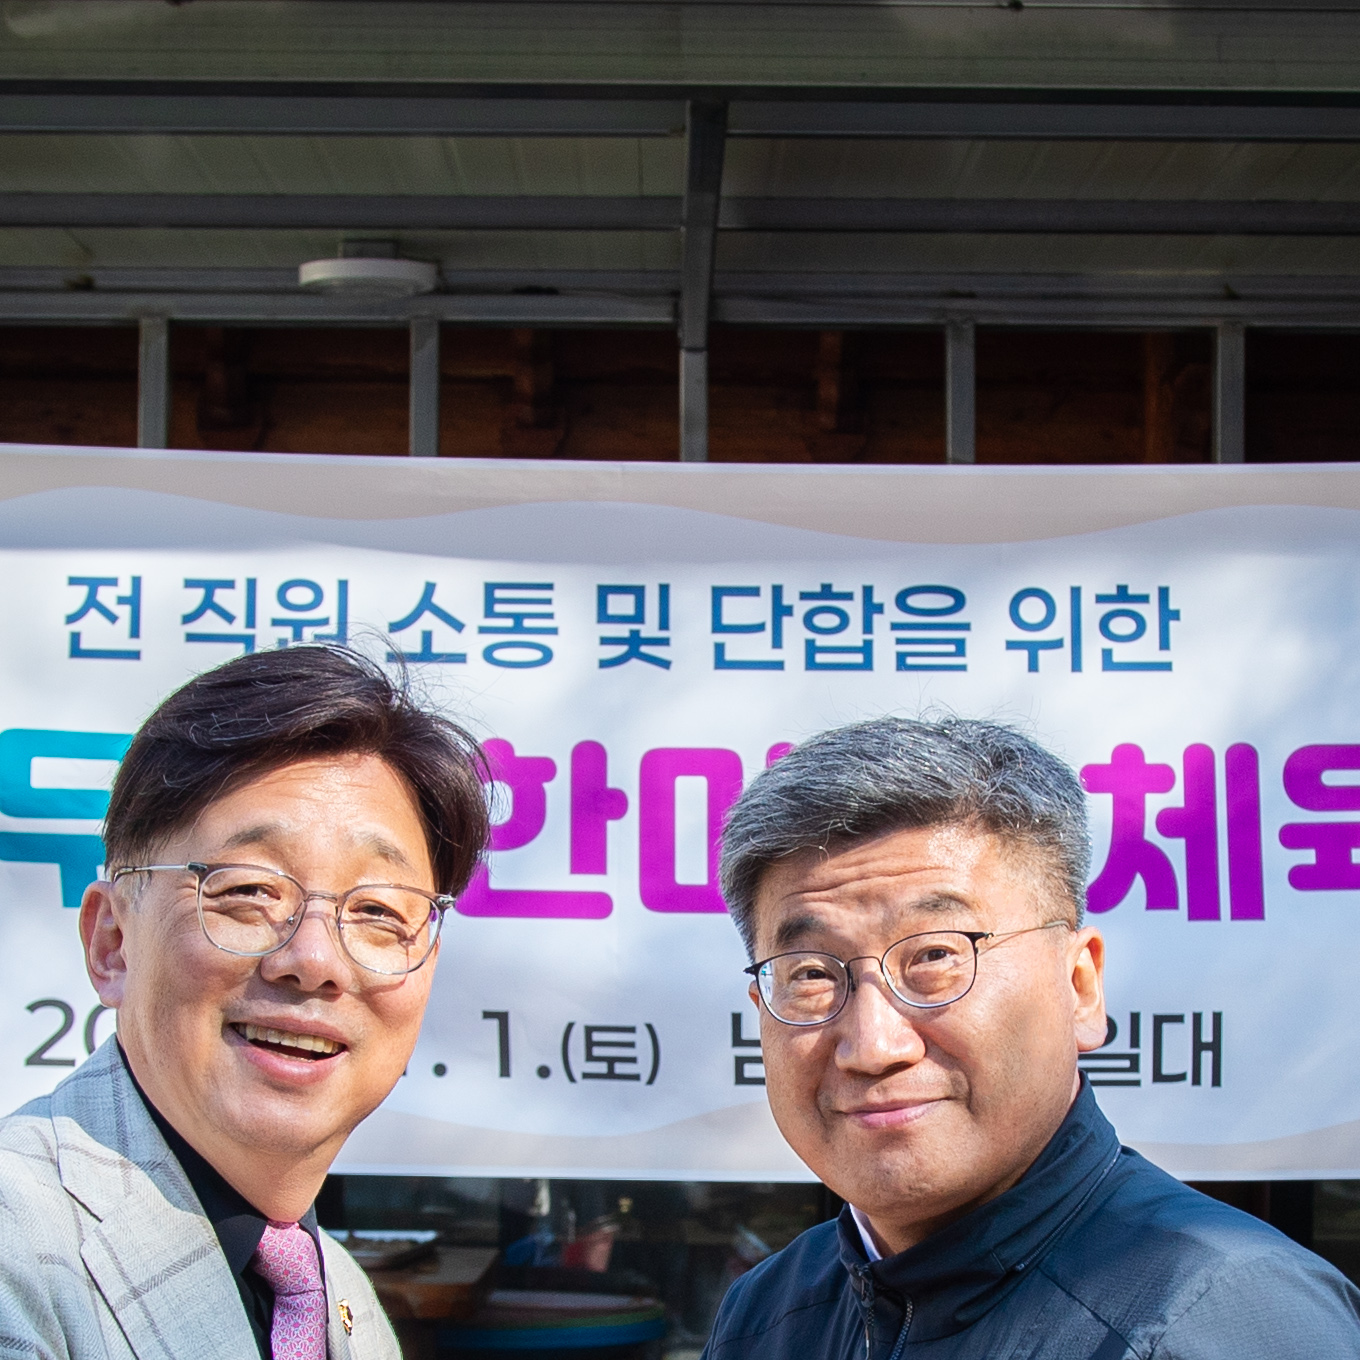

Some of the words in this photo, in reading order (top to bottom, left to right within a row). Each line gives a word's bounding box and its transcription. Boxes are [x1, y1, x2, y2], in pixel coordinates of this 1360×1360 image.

[65, 575, 142, 661] 전
[181, 577, 349, 655] 직원
[386, 580, 560, 669] 소통
[596, 583, 672, 671] 및
[711, 582, 971, 672] 단합을
[1005, 584, 1180, 673] 위한
